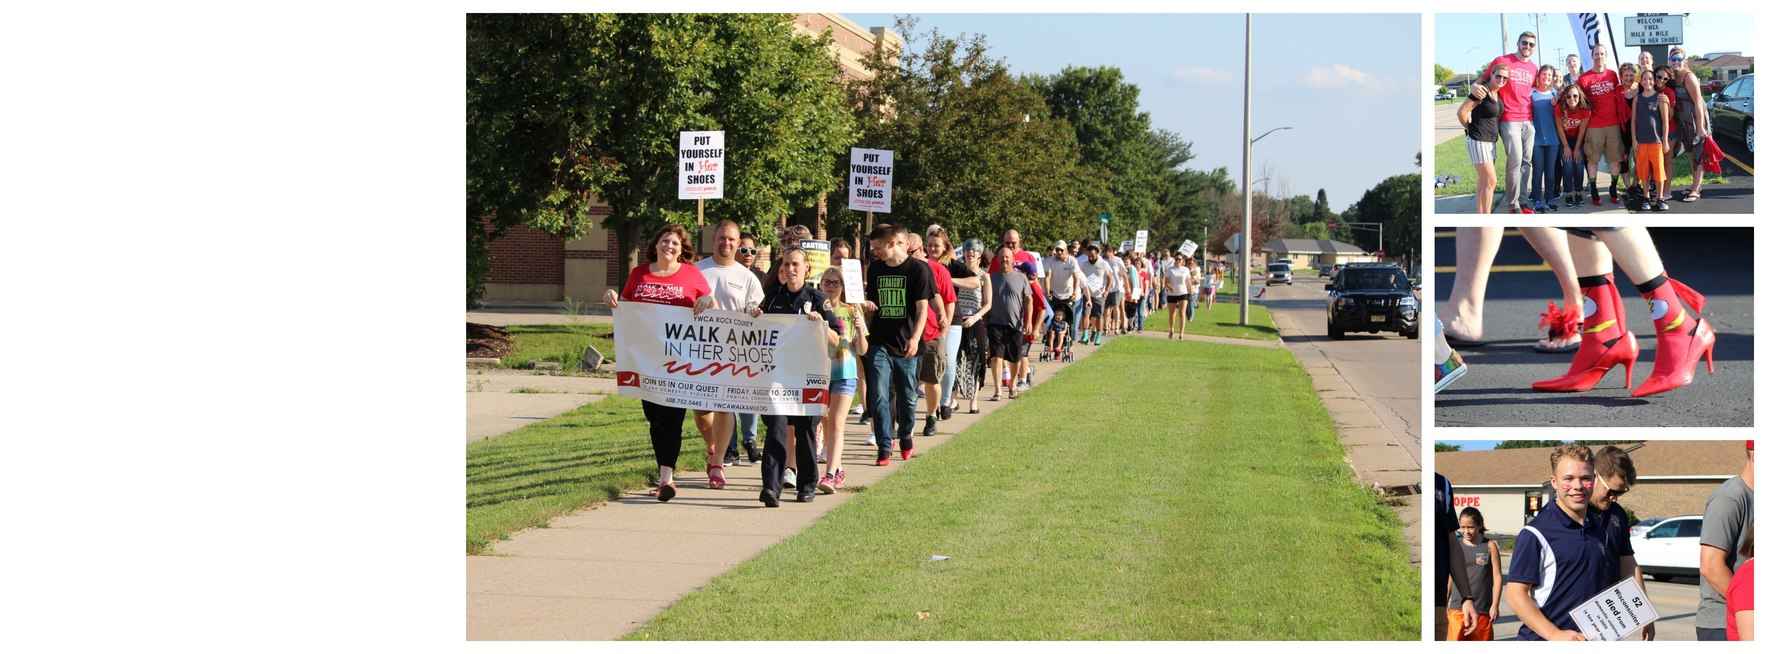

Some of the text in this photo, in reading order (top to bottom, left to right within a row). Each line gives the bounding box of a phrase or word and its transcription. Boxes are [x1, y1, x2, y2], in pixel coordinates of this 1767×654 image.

[694, 136, 711, 145] PUT
[681, 149, 723, 158] YOURSELF
[863, 153, 880, 162] PUT
[685, 162, 694, 171] IN
[852, 165, 892, 175] YOURSELF
[687, 175, 715, 184] SHOES
[855, 177, 863, 185] IN
[856, 188, 883, 198] SHOES
[734, 319, 753, 327] COUNTY
[665, 322, 779, 346] WALK A MILE
[665, 341, 774, 363] IN HER SHOES
[642, 377, 657, 385] JOIN
[659, 379, 666, 387] US
[677, 382, 693, 390] OUR
[695, 384, 719, 393] QUEST
[806, 377, 827, 386] ywca
[1605, 598, 1620, 616] died
[1632, 597, 1643, 608] 52
